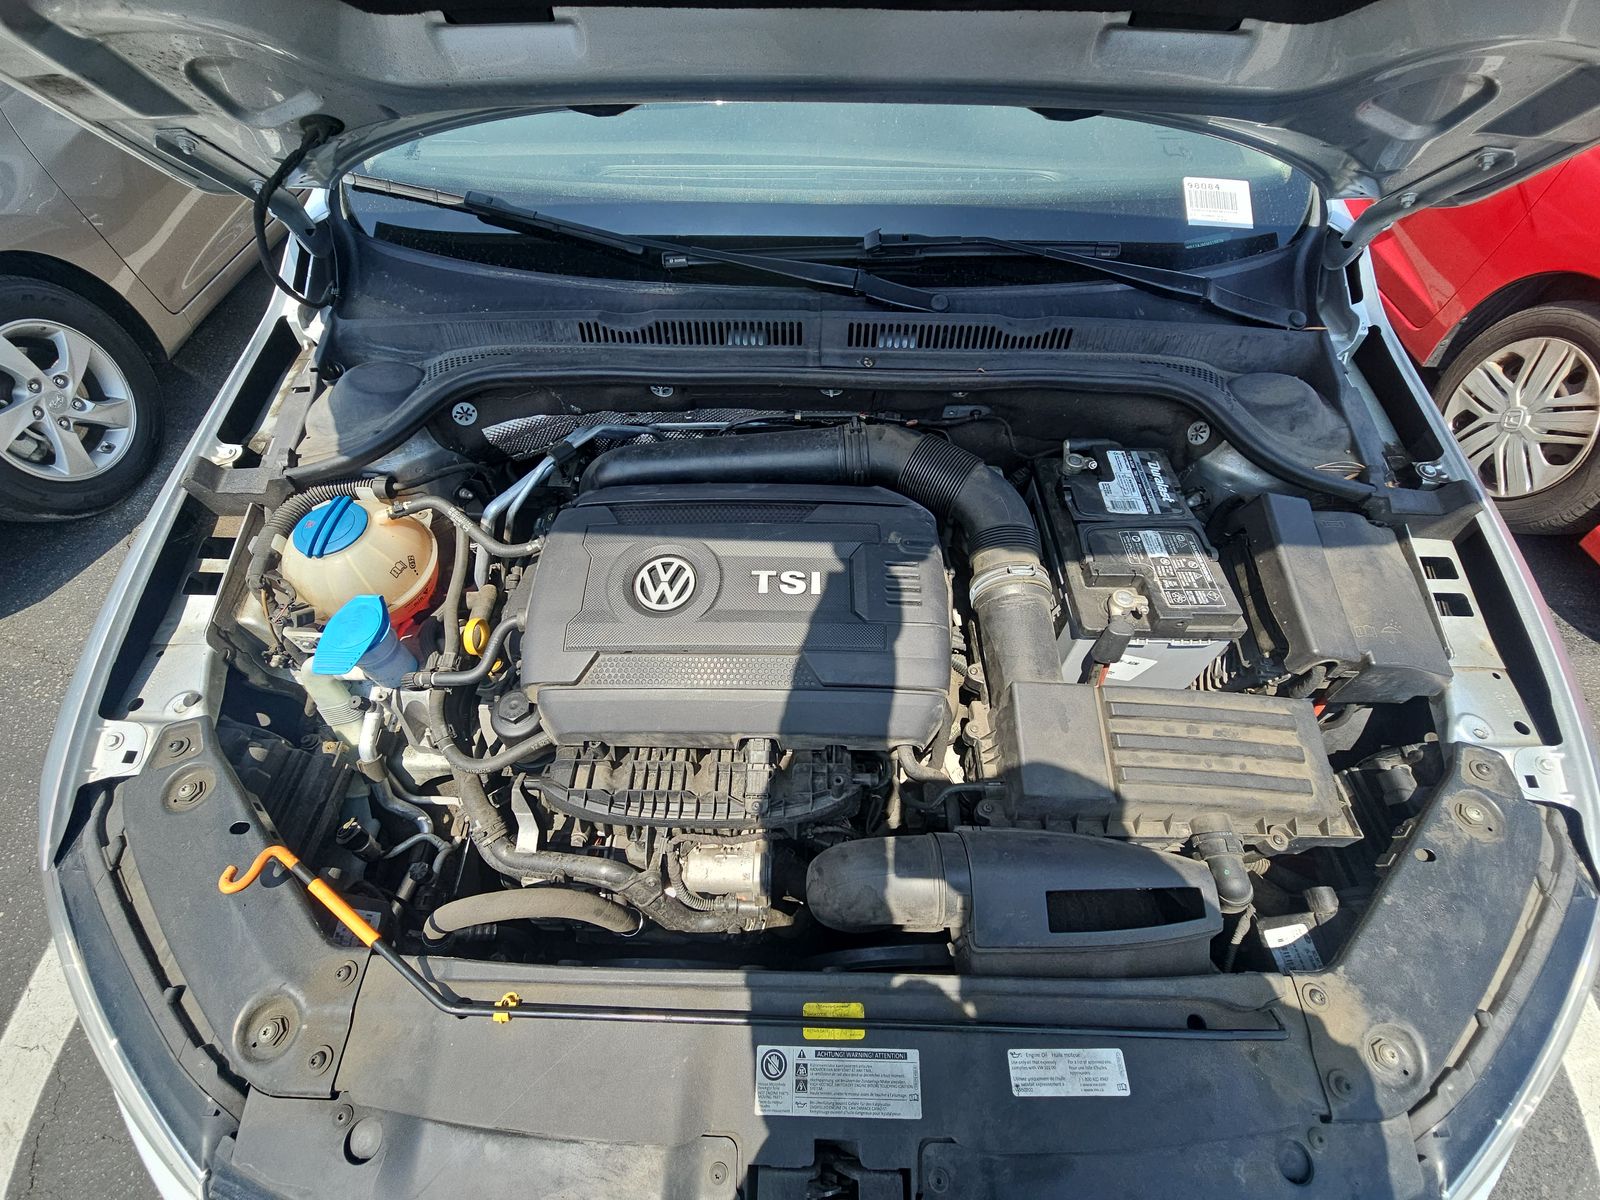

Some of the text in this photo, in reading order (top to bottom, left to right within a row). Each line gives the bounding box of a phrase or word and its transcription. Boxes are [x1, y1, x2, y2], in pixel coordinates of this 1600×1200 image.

[1187, 182, 1220, 190] 98084
[1147, 460, 1175, 503] Duralast
[751, 570, 821, 595] TSI
[875, 1052, 906, 1060] ATTENTION!
